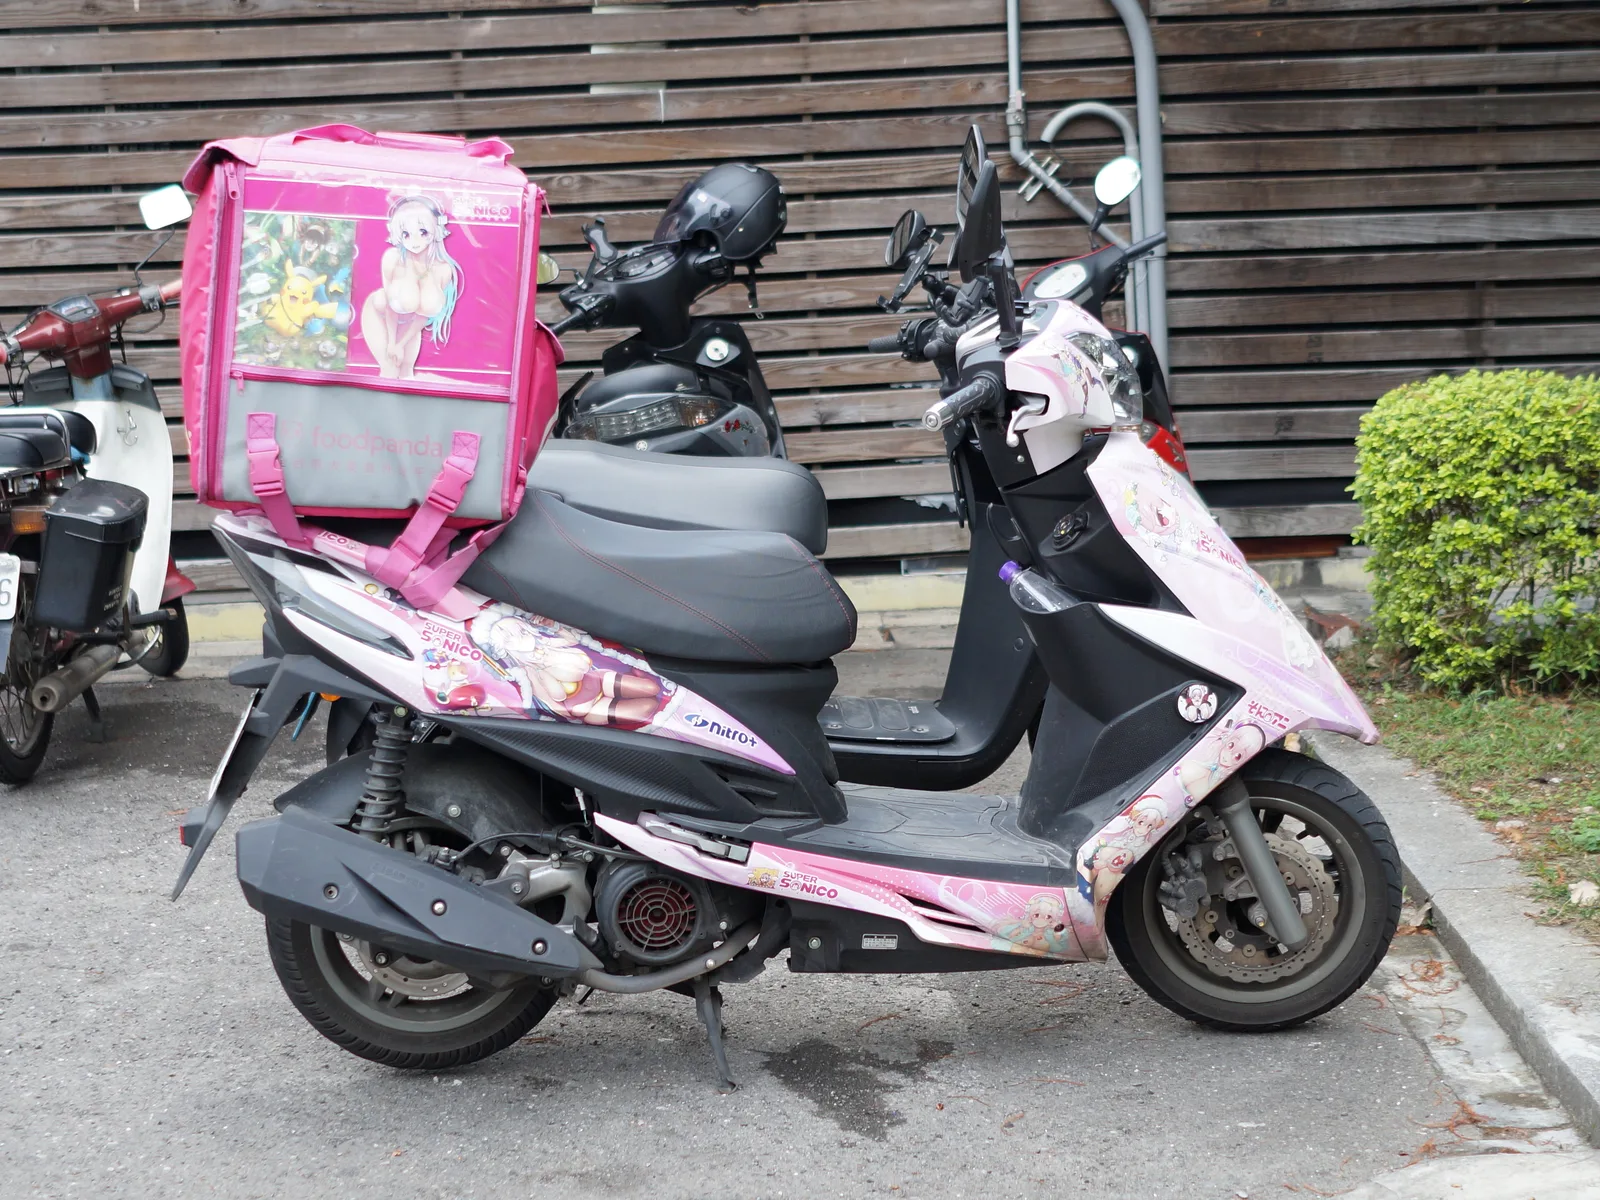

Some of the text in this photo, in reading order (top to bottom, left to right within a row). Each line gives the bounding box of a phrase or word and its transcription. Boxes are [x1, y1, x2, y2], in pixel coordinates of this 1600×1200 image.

[311, 426, 443, 456] foodpanda
[424, 622, 461, 641] SUPER
[421, 630, 481, 660] SONICO
[709, 721, 757, 747] nitro+
[779, 878, 838, 899] SONICO
[783, 870, 817, 884] SUPER
